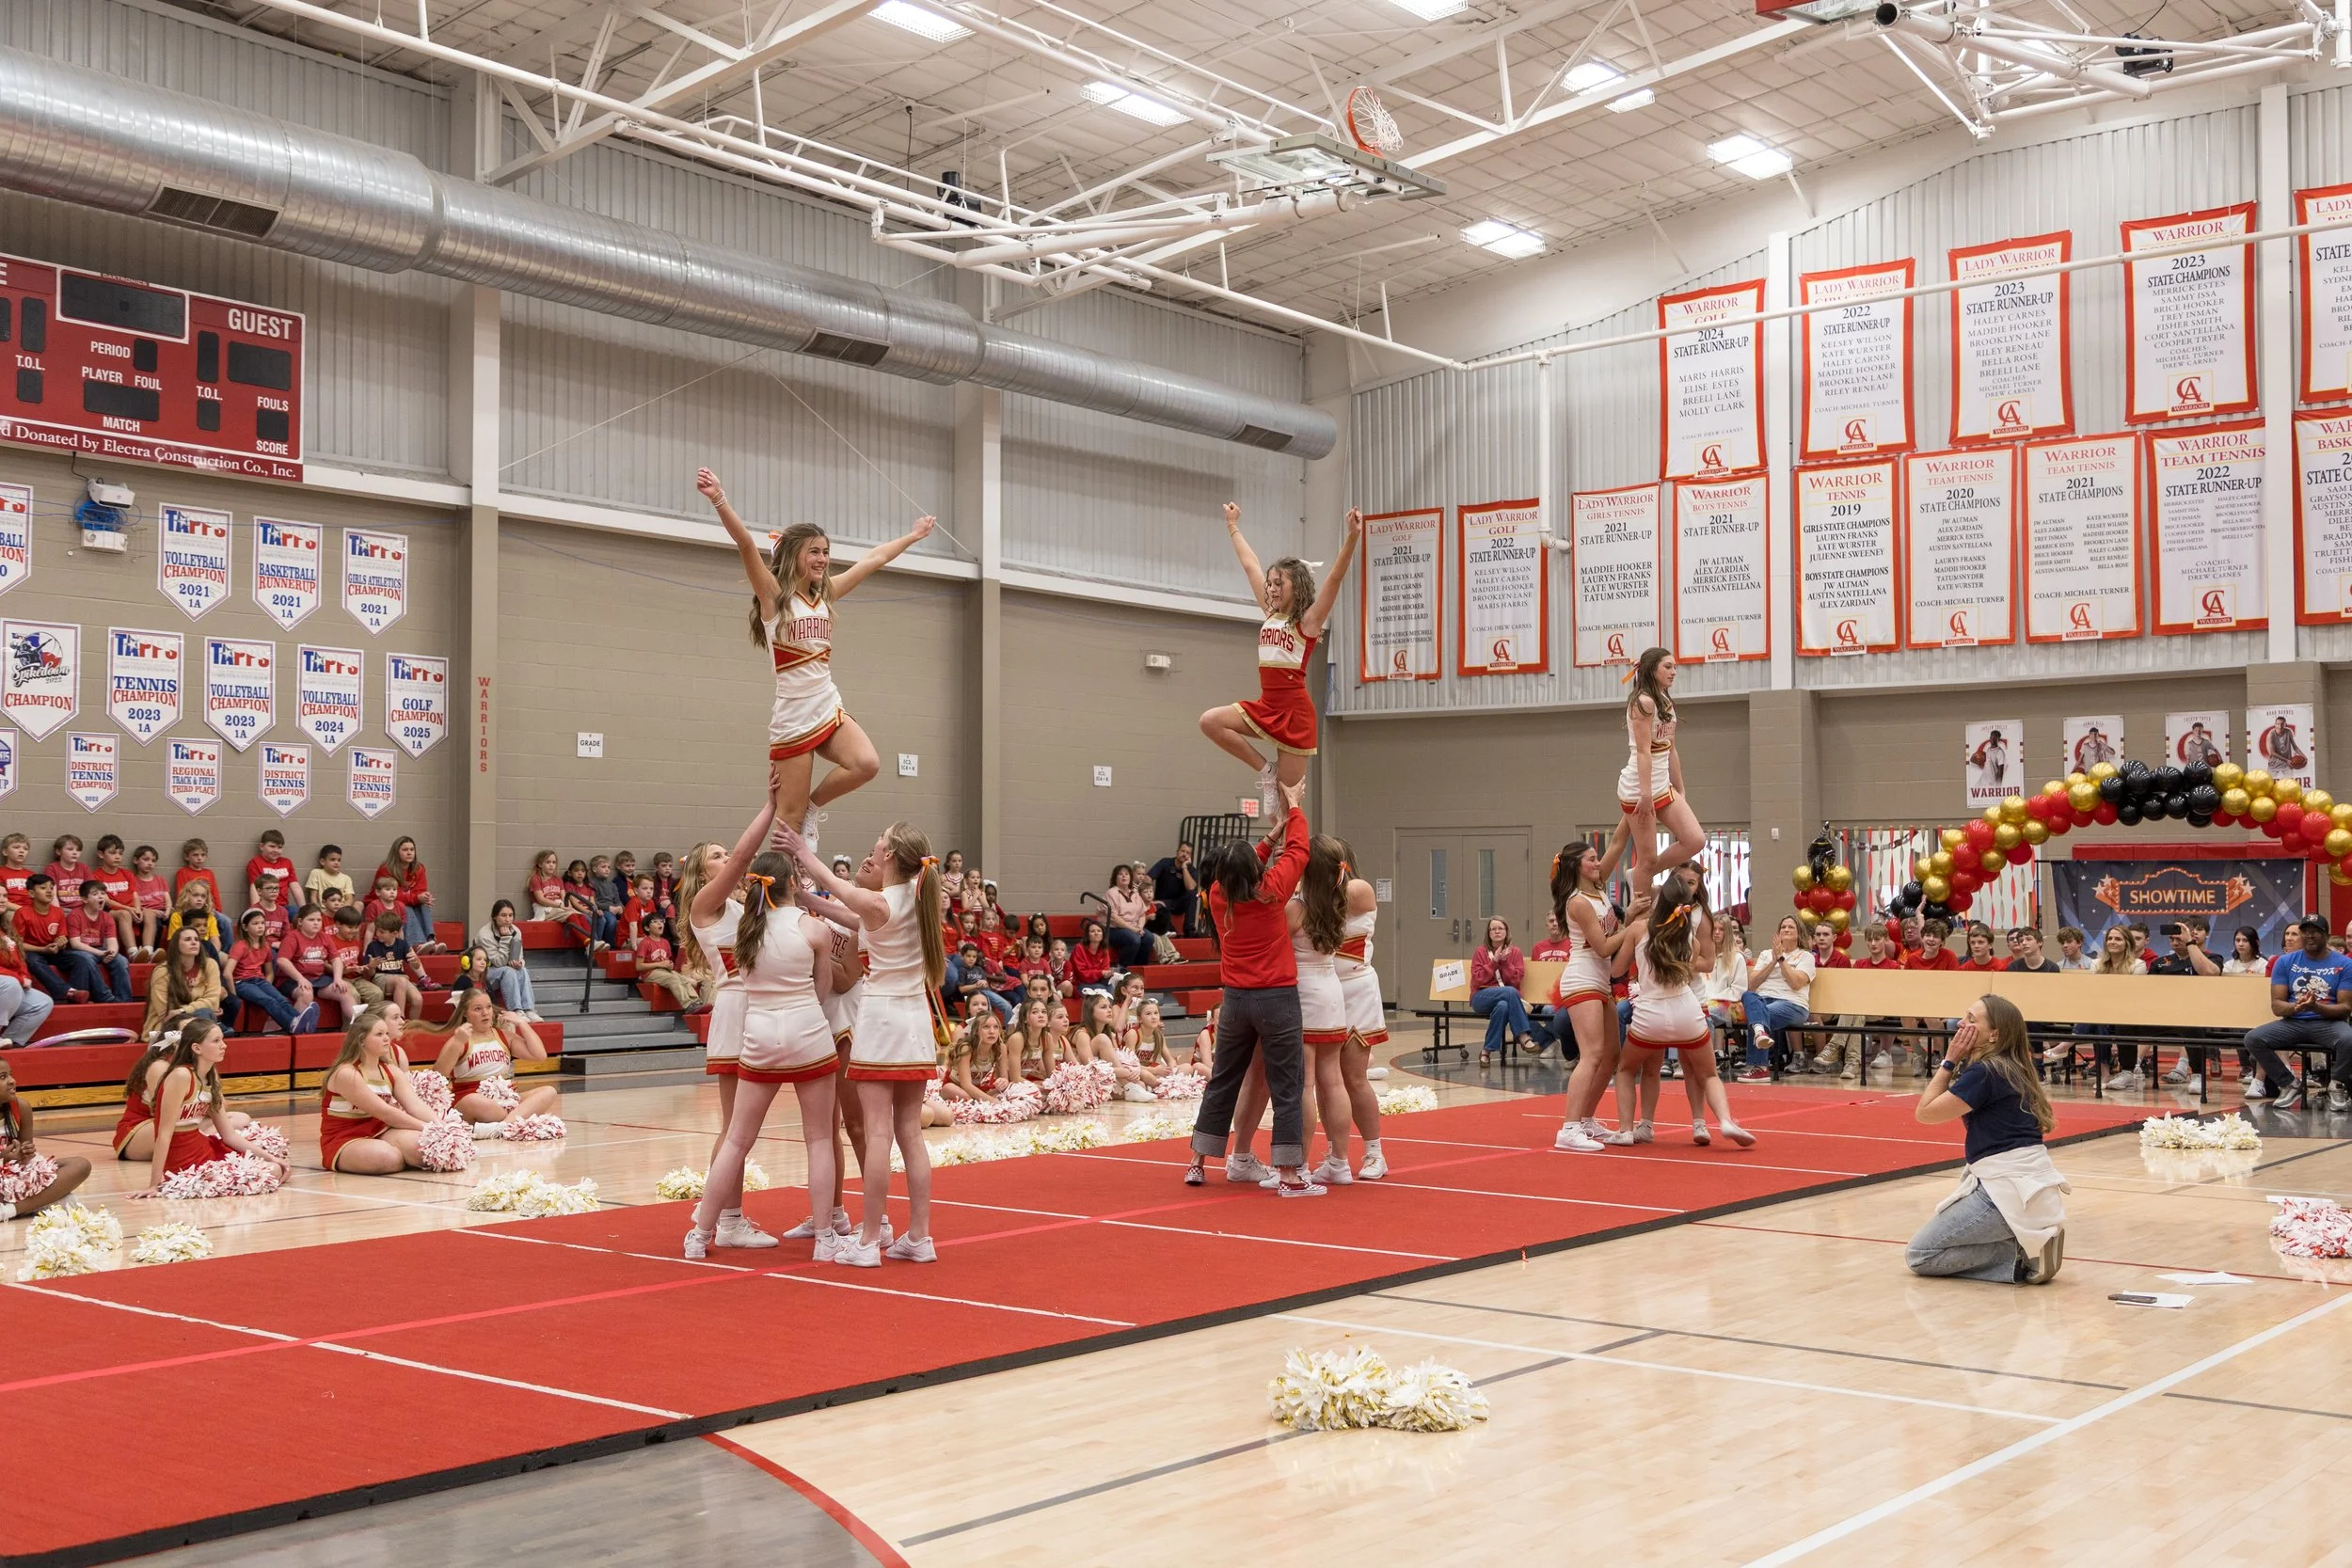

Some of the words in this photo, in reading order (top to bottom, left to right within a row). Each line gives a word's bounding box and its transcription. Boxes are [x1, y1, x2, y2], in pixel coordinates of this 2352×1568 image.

[2153, 222, 2223, 242] WARRIOR
[1964, 259, 1996, 272] LADY
[2000, 248, 2055, 265] WARRIOR
[2316, 245, 2350, 261] STATE
[2171, 255, 2205, 270] 2023
[103, 273, 147, 286] DAKTRONICS
[2148, 273, 2174, 288] STATE
[2176, 265, 2231, 284] CHAMPIONS
[1815, 283, 1844, 294] LADY
[1848, 275, 1899, 290] WARRIOR
[1994, 282, 2024, 296] 2023
[1683, 297, 1739, 314] WARRIOR
[1966, 300, 1995, 315] STATE
[1997, 293, 2053, 310] RUNNER-UP
[2153, 304, 2181, 313] BRICE
[2184, 298, 2224, 309] HOOKER
[1843, 306, 1871, 319] 2022
[228, 309, 293, 340] GUEST
[1824, 323, 1846, 335] STATE
[1848, 318, 1890, 333] RUNNER-UP
[1698, 329, 1724, 341] 2024
[91, 341, 131, 358] PERIOD
[1674, 343, 1699, 358] STATE
[1701, 336, 1749, 354] RUNNER-UP
[16, 355, 45, 371] T.O.L.
[82, 366, 122, 384] PLAYER
[135, 375, 163, 390] FOUL
[197, 386, 223, 401] T.O.L.
[257, 396, 289, 412] FOULS
[1679, 406, 1709, 419] MOLLY
[1714, 401, 1744, 412] CLARK
[103, 417, 140, 433] MATCH
[256, 440, 288, 455] SCORE
[2178, 434, 2248, 451] WARRIOR
[16, 426, 78, 447] Donated
[82, 435, 100, 452] by
[103, 439, 151, 458] Electra
[154, 446, 240, 469] Construction
[243, 460, 268, 475] Co.,
[273, 463, 296, 478] Inc.
[2044, 447, 2116, 462] WARRIOR
[2161, 453, 2204, 467] TEAM
[2208, 448, 2265, 462] TENNIS
[1926, 459, 1994, 473] WARRIOR
[1810, 472, 1883, 489] WARRIOR
[1927, 476, 1955, 485] TEAM
[1957, 473, 1993, 483] TENNIS
[2197, 466, 2230, 481] 2022
[2066, 477, 2094, 489] 2021
[2166, 483, 2198, 498] STATE
[2200, 477, 2262, 493] RUNNER-UP
[1692, 486, 1751, 500] WARRIOR
[1826, 489, 1866, 500] TENNIS
[1947, 488, 1974, 499] 2020
[2039, 492, 2066, 503] STATE
[2069, 486, 2123, 500] CHAMPIONS
[1578, 499, 1604, 510] LADY
[1605, 495, 1654, 506] WARRIOR
[1692, 503, 1714, 512] BOYS
[1717, 500, 1747, 509] TENNIS
[1587, 511, 1611, 520] GIRLS
[1613, 509, 1645, 517] TENNIS
[1831, 504, 1861, 516] 2019
[1470, 515, 1493, 526] LADY
[1497, 512, 1537, 522] WARRIOR
[1709, 515, 1733, 525] 2021
[1804, 524, 1822, 533] GIRLS
[1823, 521, 1845, 531] STATE
[1847, 517, 1890, 530] CHAMPIONS
[1370, 524, 1394, 534] LADY
[1395, 520, 1436, 531] WARRIOR
[1489, 526, 1518, 535] GOLF
[1604, 523, 1627, 532] 2021
[1684, 527, 1710, 537] STATE
[1711, 522, 1759, 534] RUNNER-UP
[1491, 538, 1514, 548] 2022
[1581, 535, 1604, 546] STATE
[1606, 531, 1651, 543] RUNNER-UP
[1393, 546, 1412, 556] 2021
[1470, 551, 1492, 562] STATE
[1493, 547, 1535, 561] RUNNER-UP
[166, 551, 226, 570] VOLLEYBALL
[165, 565, 225, 584] CHAMPION
[259, 563, 315, 580] BASKETBALL
[1581, 565, 1614, 575] MADDIE
[1616, 562, 1652, 572] HOOKER
[1805, 571, 1821, 580] BOYS
[1822, 570, 1844, 579] STATE
[1846, 567, 1888, 578] CHAMPIONS
[258, 576, 316, 594] RUNNERUP
[348, 574, 367, 584] GIRLS
[368, 577, 402, 588] ATHLETICS
[1682, 585, 1710, 594] AUSTIN
[1711, 582, 1761, 592] SANTELLANA
[1823, 582, 1835, 591] JW
[1836, 579, 1868, 589] ALTMAN
[179, 583, 210, 597] 2021
[348, 584, 401, 601] CHAMPION
[2034, 591, 2062, 599] COACH:
[2064, 589, 2097, 597] MICHAEL
[2099, 586, 2129, 594] TURNER
[189, 599, 201, 609] 1A
[272, 594, 301, 608] 2021
[281, 609, 294, 618] 1A
[360, 603, 388, 615] 2021
[370, 617, 380, 626] 1A
[787, 617, 831, 642] WARRIO
[1258, 628, 1295, 652] RRIORS
[11, 661, 71, 688] Spikedown
[114, 676, 177, 692] TENNIS
[113, 689, 177, 707] CHAMPION
[210, 684, 269, 699] VOLLEYBALL
[302, 690, 358, 705] VOLLEYBALL
[5, 692, 72, 711] CHAMPION
[210, 697, 270, 713] CHAMPION
[402, 698, 433, 711] GOLF
[128, 708, 161, 721] 2023
[302, 704, 358, 720] CHAMPION
[390, 709, 443, 725] CHAMPION
[138, 723, 151, 733] 1A
[225, 715, 256, 727] 2023
[315, 721, 344, 733] 2024
[478, 677, 491, 772] WARRIORS
[235, 730, 246, 738] 1A
[324, 735, 336, 744] 1A
[404, 727, 431, 738] 2025
[412, 740, 422, 749] 1A
[71, 762, 113, 771] DISTRICT
[172, 767, 215, 777] REGIONAL
[72, 771, 113, 781] TENNIS
[172, 776, 192, 784] TRACK
[199, 776, 215, 785] FIELD
[264, 769, 305, 779] DISTRICT
[353, 774, 391, 784] DISTRICT
[71, 781, 113, 791] CHAMPION
[172, 785, 193, 794] THIRD
[196, 785, 215, 796] PLACE
[264, 779, 305, 788] TENNIS
[353, 783, 390, 792] TENNIS
[263, 787, 305, 797] CHAMPION
[352, 791, 390, 800] RUNNER-UP
[1971, 786, 2020, 798] WARRIOR
[2130, 889, 2216, 905] SHOWTIME
[1439, 970, 1458, 979] GRADE
[468, 1049, 509, 1069] WARRIORS
